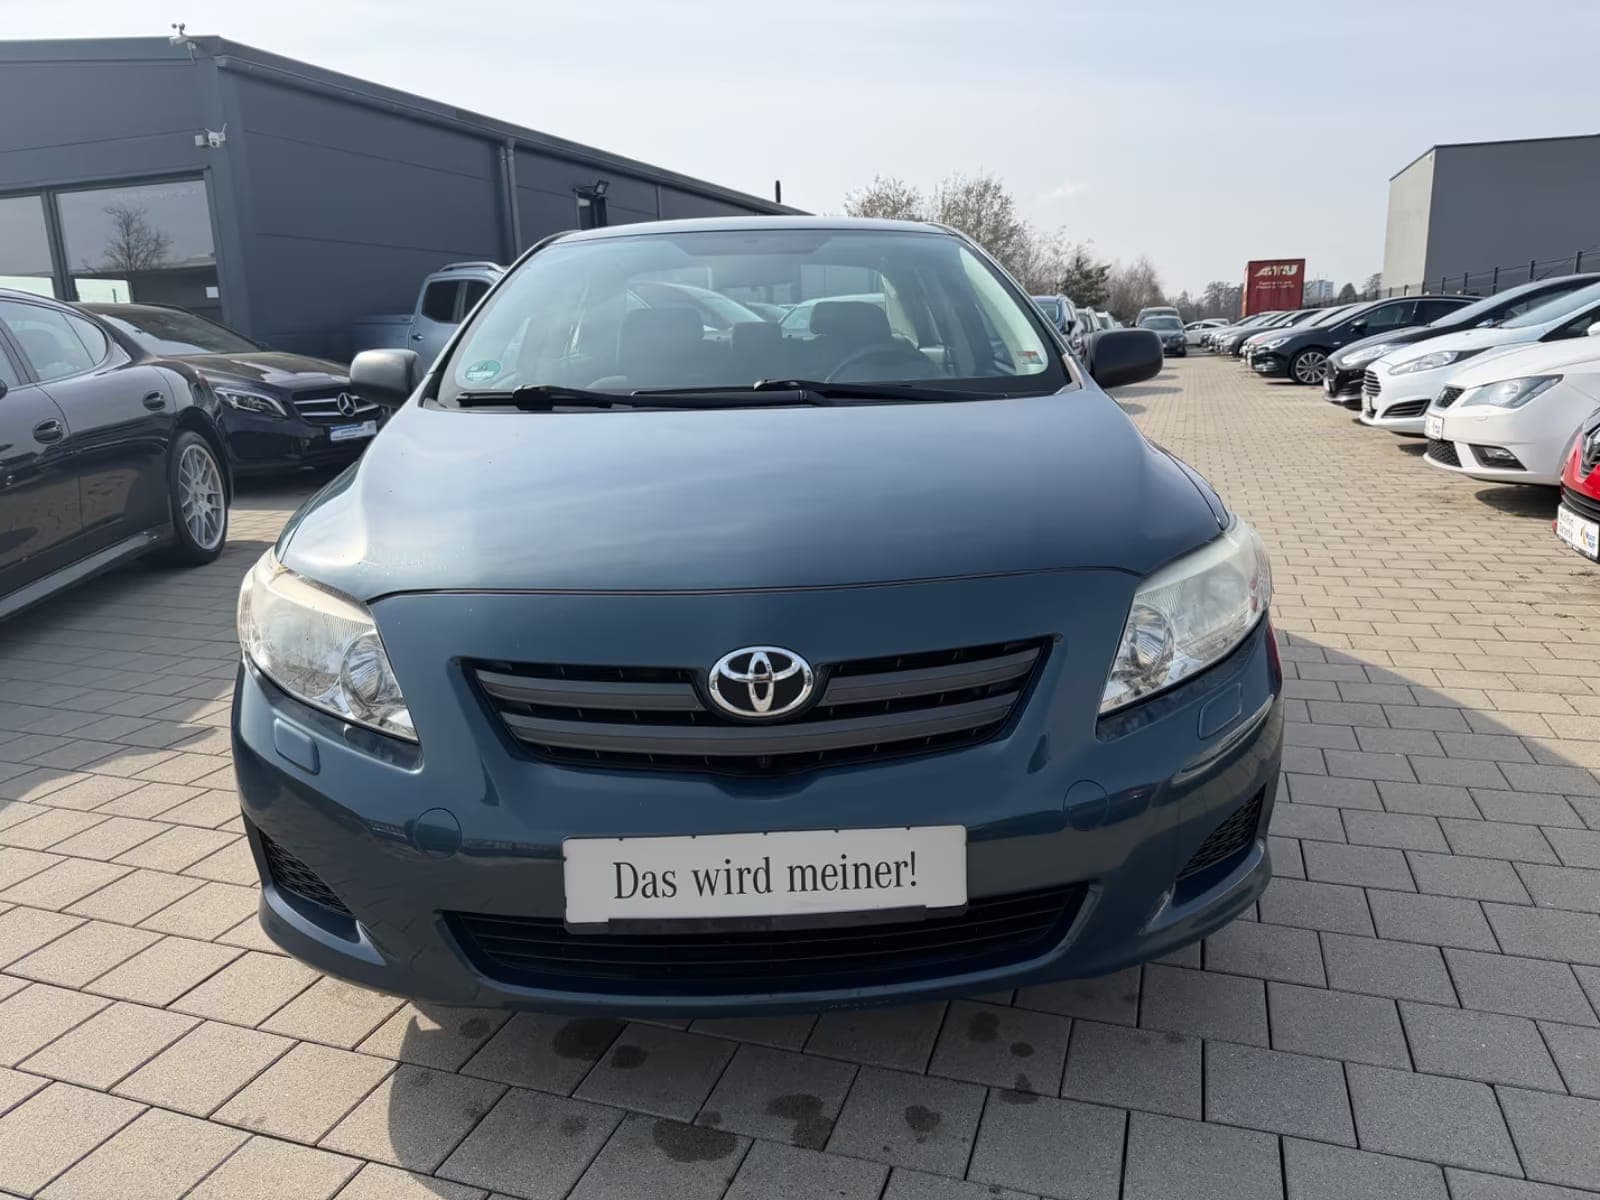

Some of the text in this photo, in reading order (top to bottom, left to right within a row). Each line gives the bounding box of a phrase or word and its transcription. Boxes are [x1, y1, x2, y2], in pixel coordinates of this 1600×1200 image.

[613, 850, 917, 899] Das wird meiner!
